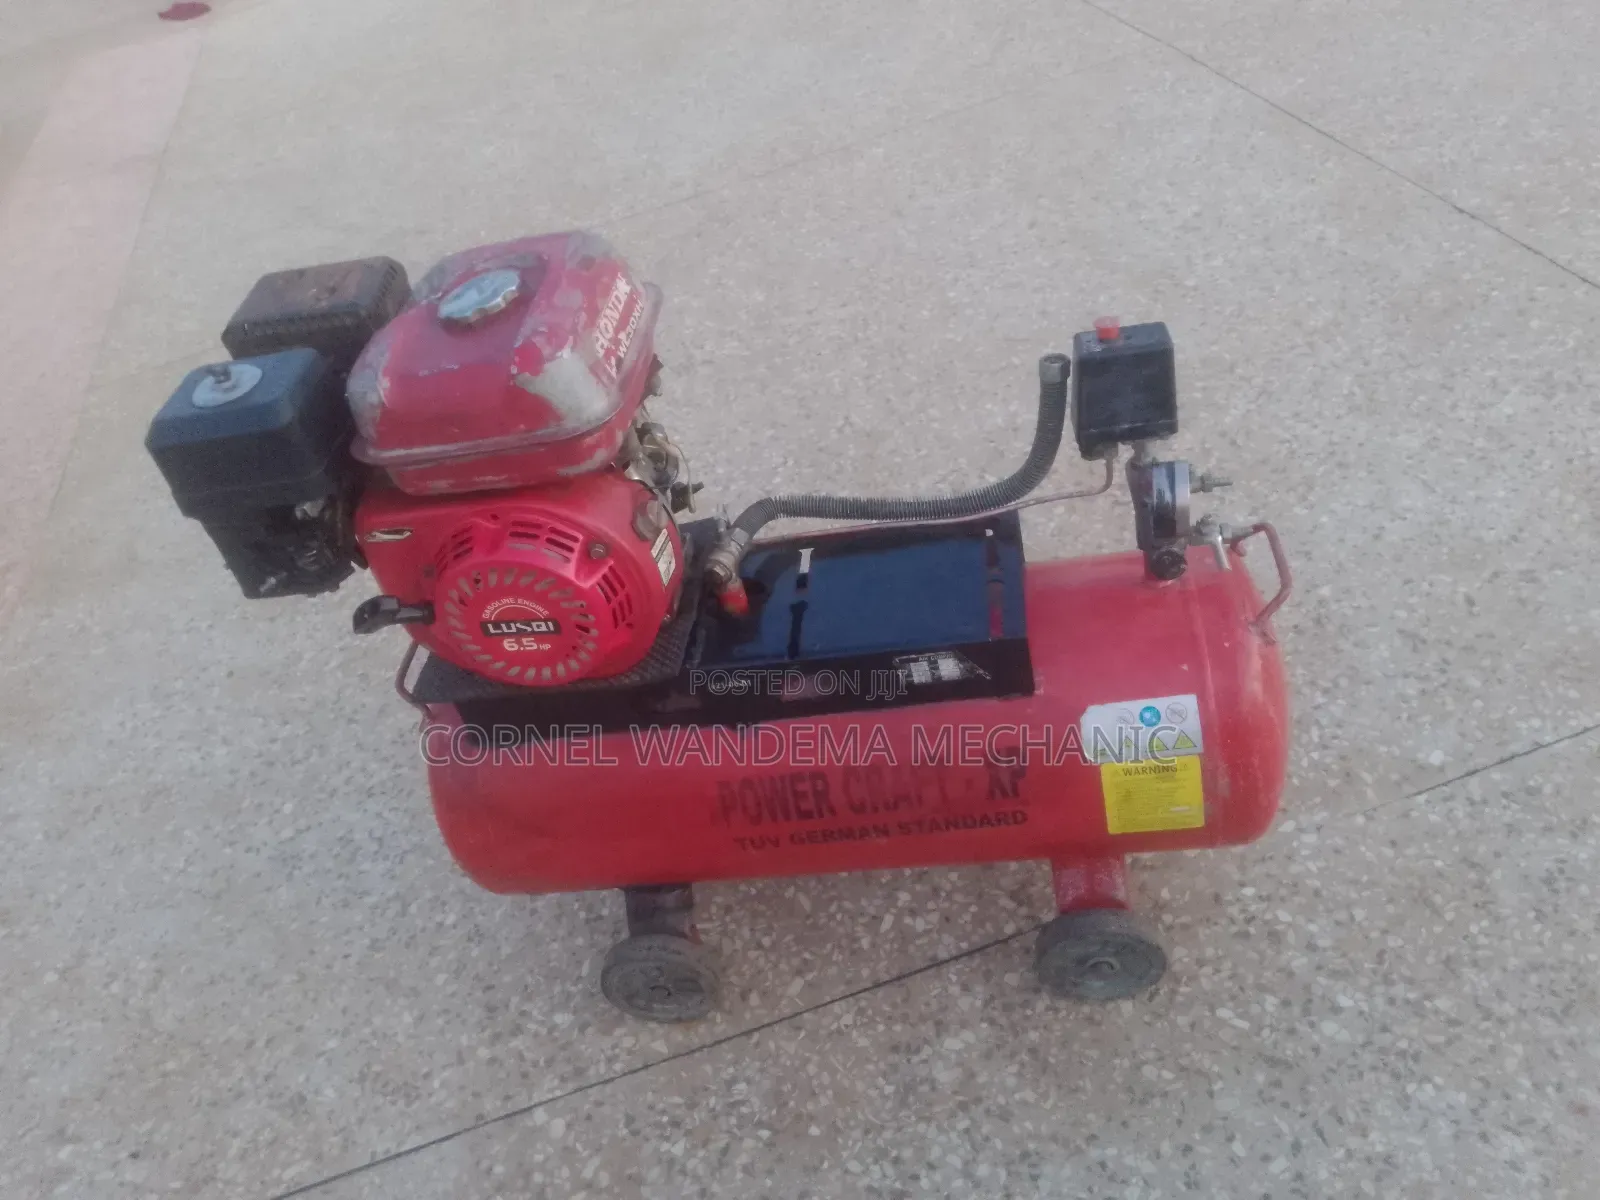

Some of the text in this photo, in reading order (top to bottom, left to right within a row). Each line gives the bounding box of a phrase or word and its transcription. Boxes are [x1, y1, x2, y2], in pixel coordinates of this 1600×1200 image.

[482, 598, 550, 619] GASOLINE ENGINE
[503, 637, 552, 651] 6.5 HP
[1122, 765, 1178, 777] WARNING
[713, 770, 837, 827] POWER
[789, 823, 890, 845] GERMAN
[896, 809, 1029, 836] STANDARD
